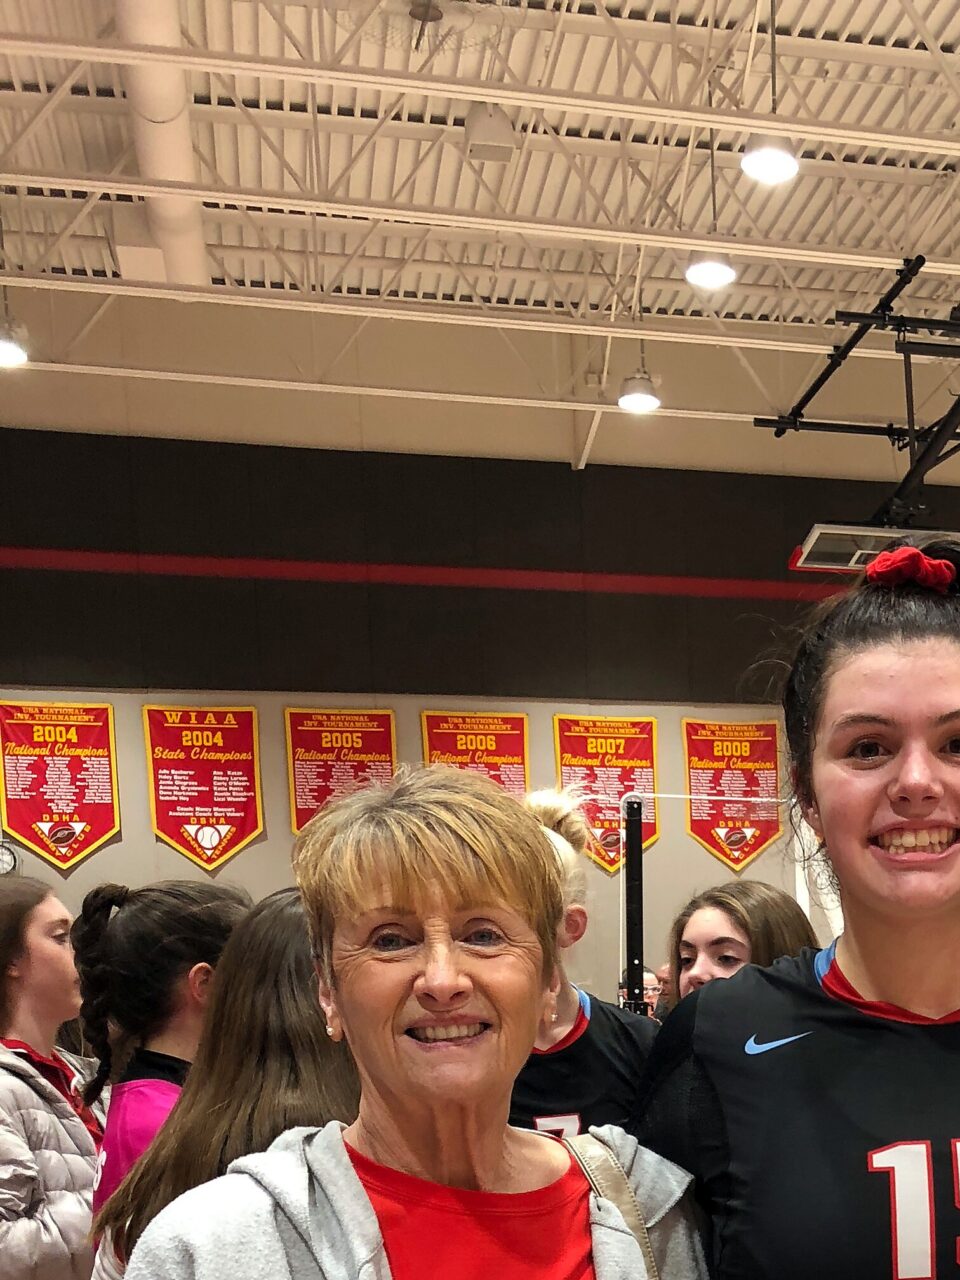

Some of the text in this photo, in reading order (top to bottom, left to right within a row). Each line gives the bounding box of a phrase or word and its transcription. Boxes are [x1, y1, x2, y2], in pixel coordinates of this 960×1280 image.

[33, 726, 78, 743] 2004
[182, 731, 223, 747] 2004
[321, 732, 362, 748] 2005
[456, 735, 497, 750] 2006
[4, 742, 108, 758] National Champions
[586, 738, 626, 754] 2007
[713, 741, 750, 756] 2008
[153, 747, 252, 763] State Champions
[295, 747, 390, 764] National Champions
[431, 750, 522, 766] National Champions
[561, 753, 651, 769] National Champions
[690, 756, 775, 771] National Champions
[43, 814, 80, 822] DSHA
